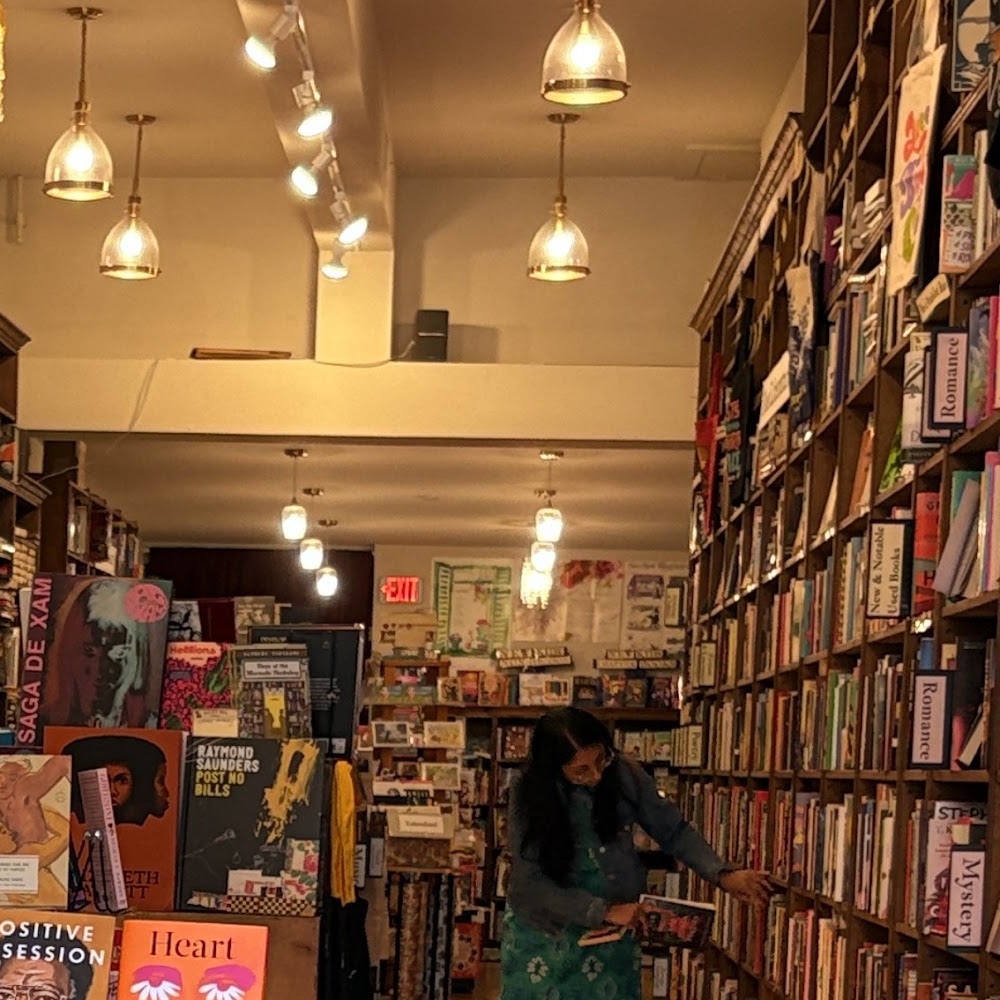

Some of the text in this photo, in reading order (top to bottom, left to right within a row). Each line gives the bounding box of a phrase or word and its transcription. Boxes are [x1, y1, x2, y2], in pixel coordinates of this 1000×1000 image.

[941, 337, 958, 418] Romance
[386, 577, 419, 602] EXIT
[870, 526, 884, 614] New & Notable
[888, 547, 900, 614] Used Books
[18, 578, 53, 744] SAGA DE XAM
[920, 682, 938, 760] Romance
[196, 758, 259, 772] SAUNDERS
[198, 745, 254, 759] RAYMOND
[195, 783, 231, 797] BILLS
[196, 772, 244, 785] POST NO
[952, 858, 981, 942] Mystery
[150, 931, 235, 960] Heart
